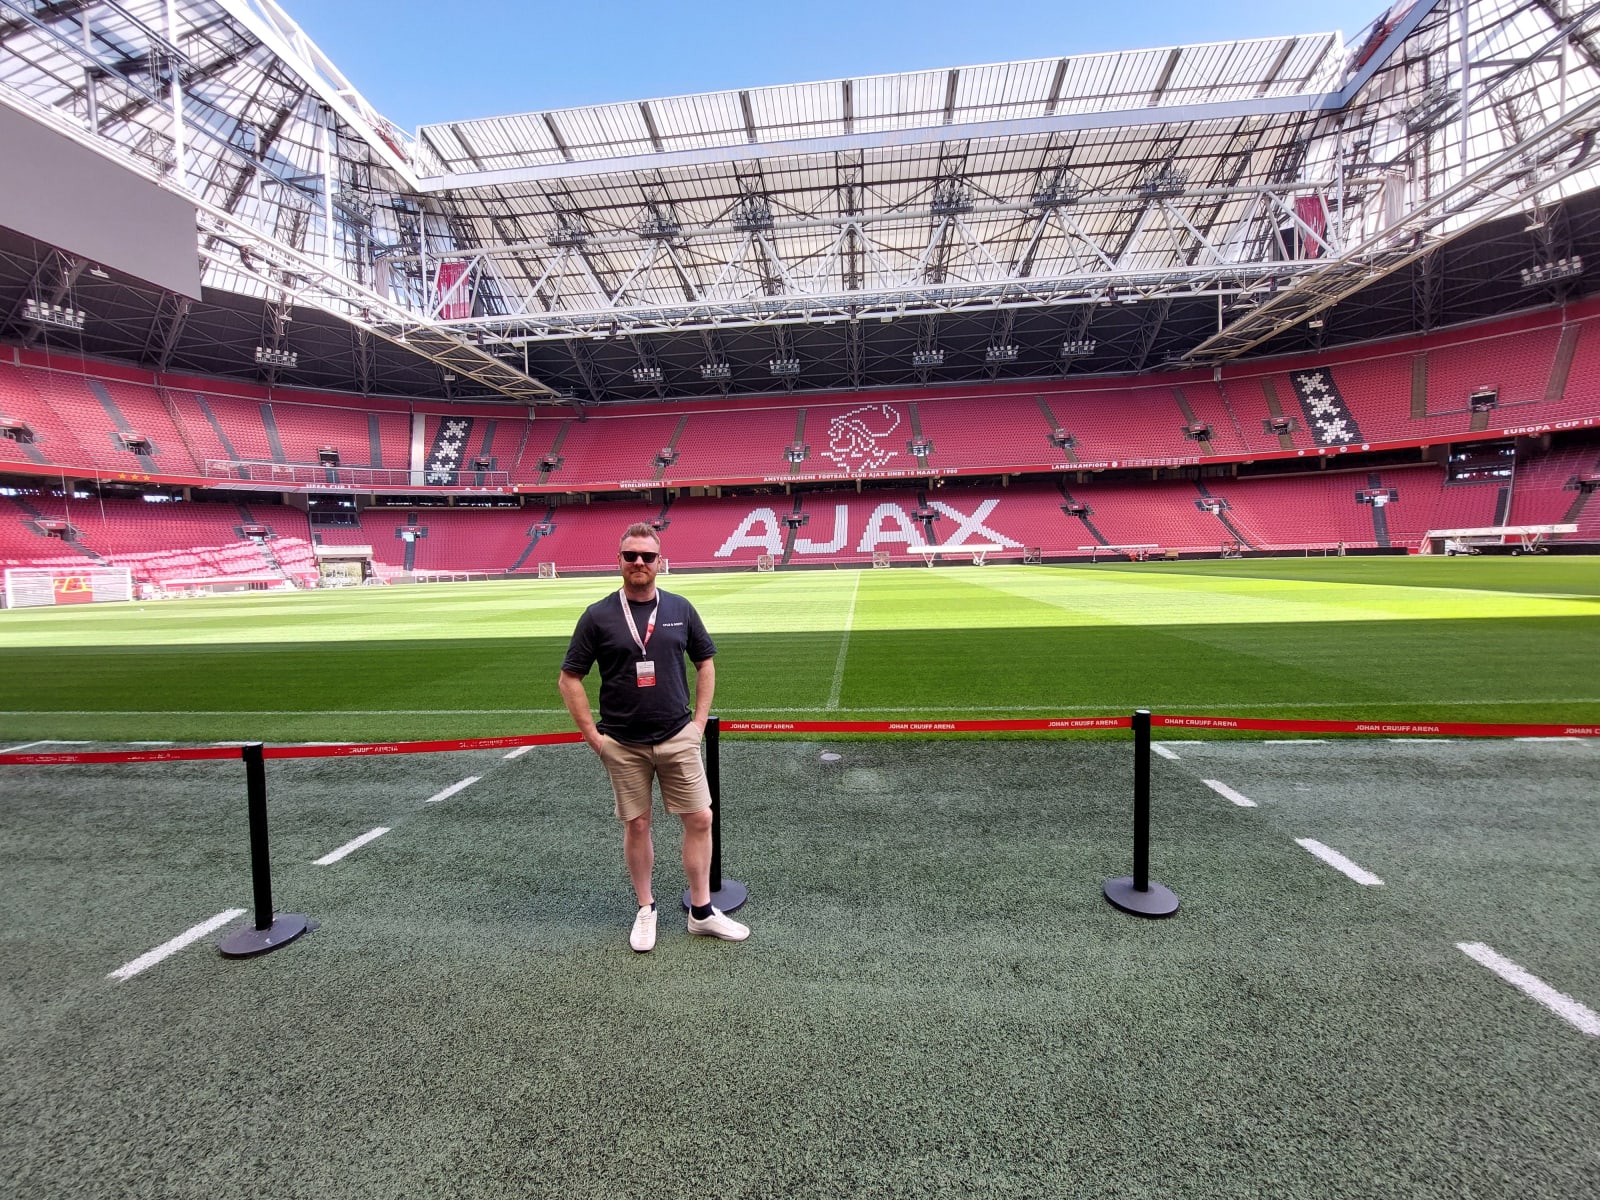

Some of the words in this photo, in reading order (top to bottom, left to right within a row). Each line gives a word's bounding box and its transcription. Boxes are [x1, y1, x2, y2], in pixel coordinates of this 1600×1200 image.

[1503, 424, 1551, 435] EUROPA
[1555, 420, 1580, 429] CUP
[1051, 462, 1109, 470] LANDSKAMPIOEN
[714, 499, 1025, 557] AJAX
